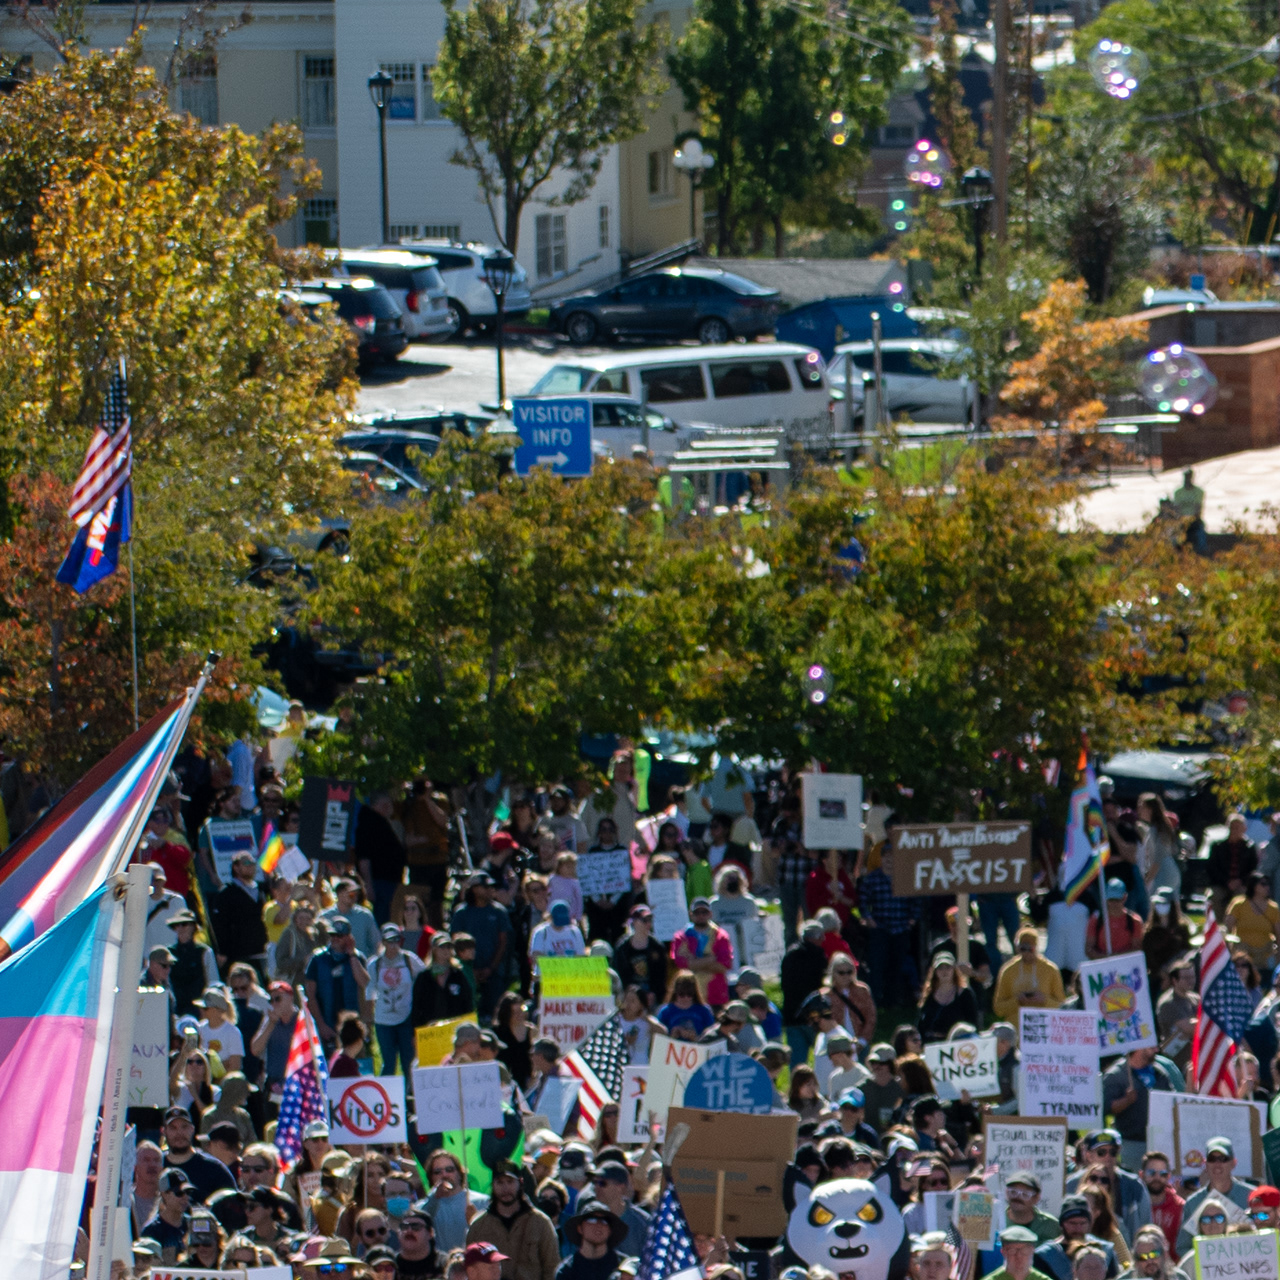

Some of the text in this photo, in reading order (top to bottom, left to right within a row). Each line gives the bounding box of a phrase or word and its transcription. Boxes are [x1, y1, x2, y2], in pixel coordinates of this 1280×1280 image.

[519, 407, 586, 423] VISITOR
[532, 428, 573, 446] INFO
[898, 830, 934, 848] ANTI
[543, 1001, 573, 1016] MAKE
[665, 1043, 699, 1070] NO
[700, 1058, 757, 1080] WE
[702, 1079, 755, 1106] THE
[1040, 1101, 1100, 1117] TYRANNY
[991, 1128, 1028, 1141] EQUAL
[1206, 1242, 1273, 1259] PANDAS
[1203, 1262, 1236, 1277] TAKE
